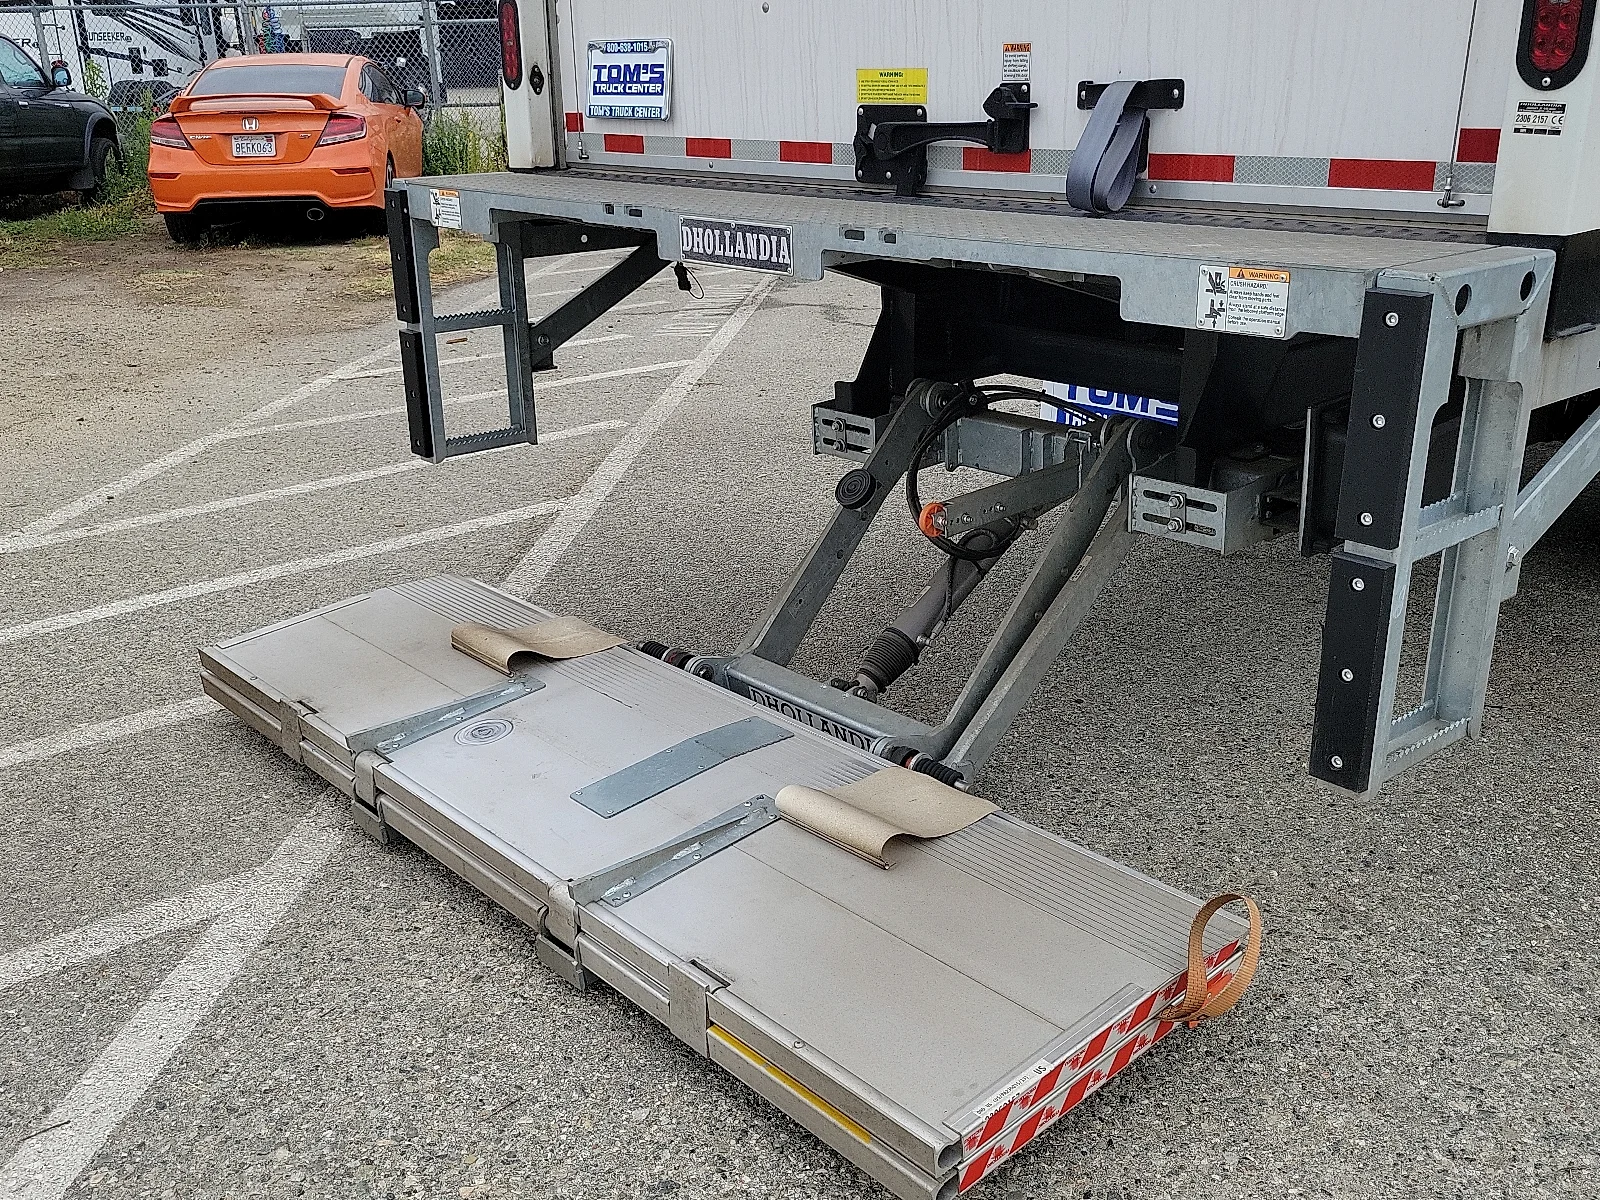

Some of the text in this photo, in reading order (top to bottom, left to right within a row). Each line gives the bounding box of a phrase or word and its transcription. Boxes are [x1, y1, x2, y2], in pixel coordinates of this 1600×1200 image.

[593, 63, 665, 82] TOM'S
[594, 83, 662, 93] TRUCK CENTER
[590, 105, 661, 118] TOM'S TRUCK CENTER
[1532, 114, 1549, 124] 2157
[681, 225, 790, 264] DHOLLANDIA
[1248, 271, 1279, 281] WARNING
[1033, 1065, 1048, 1075] US
